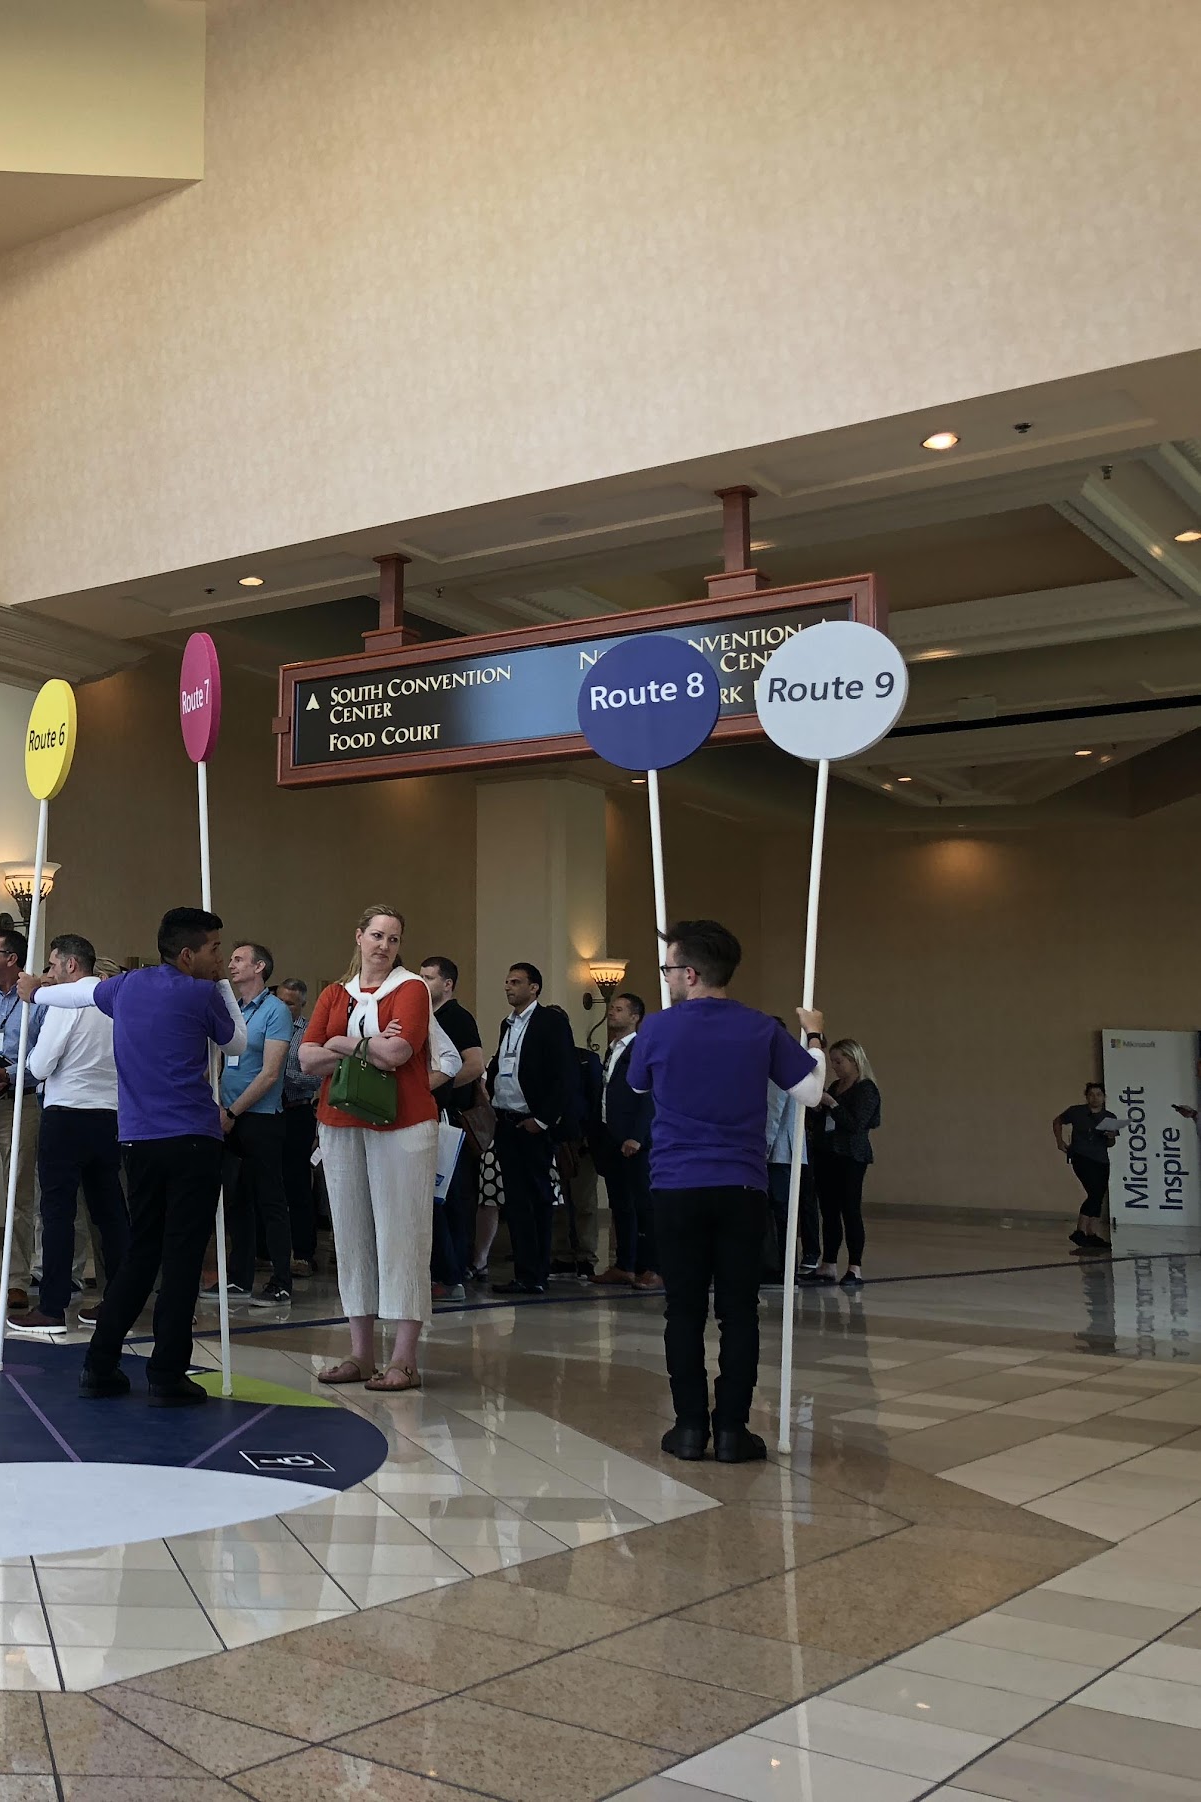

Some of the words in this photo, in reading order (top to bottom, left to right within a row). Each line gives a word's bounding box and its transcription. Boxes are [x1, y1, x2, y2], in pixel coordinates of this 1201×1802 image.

[687, 623, 802, 652] NVENTION
[182, 687, 204, 715] Route
[204, 679, 210, 705] 7
[330, 684, 383, 706] SOUTH
[387, 665, 512, 697] CONVENTION
[590, 681, 678, 711] Route
[686, 672, 705, 698] 8
[768, 676, 864, 703] Route
[875, 671, 895, 699] 9
[329, 702, 393, 725] CENTER
[28, 728, 57, 752] Route
[58, 722, 66, 746] 6
[329, 732, 376, 751] FOOD
[381, 724, 441, 745] COURT
[1119, 1086, 1149, 1209] Microsoft
[1156, 1127, 1189, 1210] Inspire
